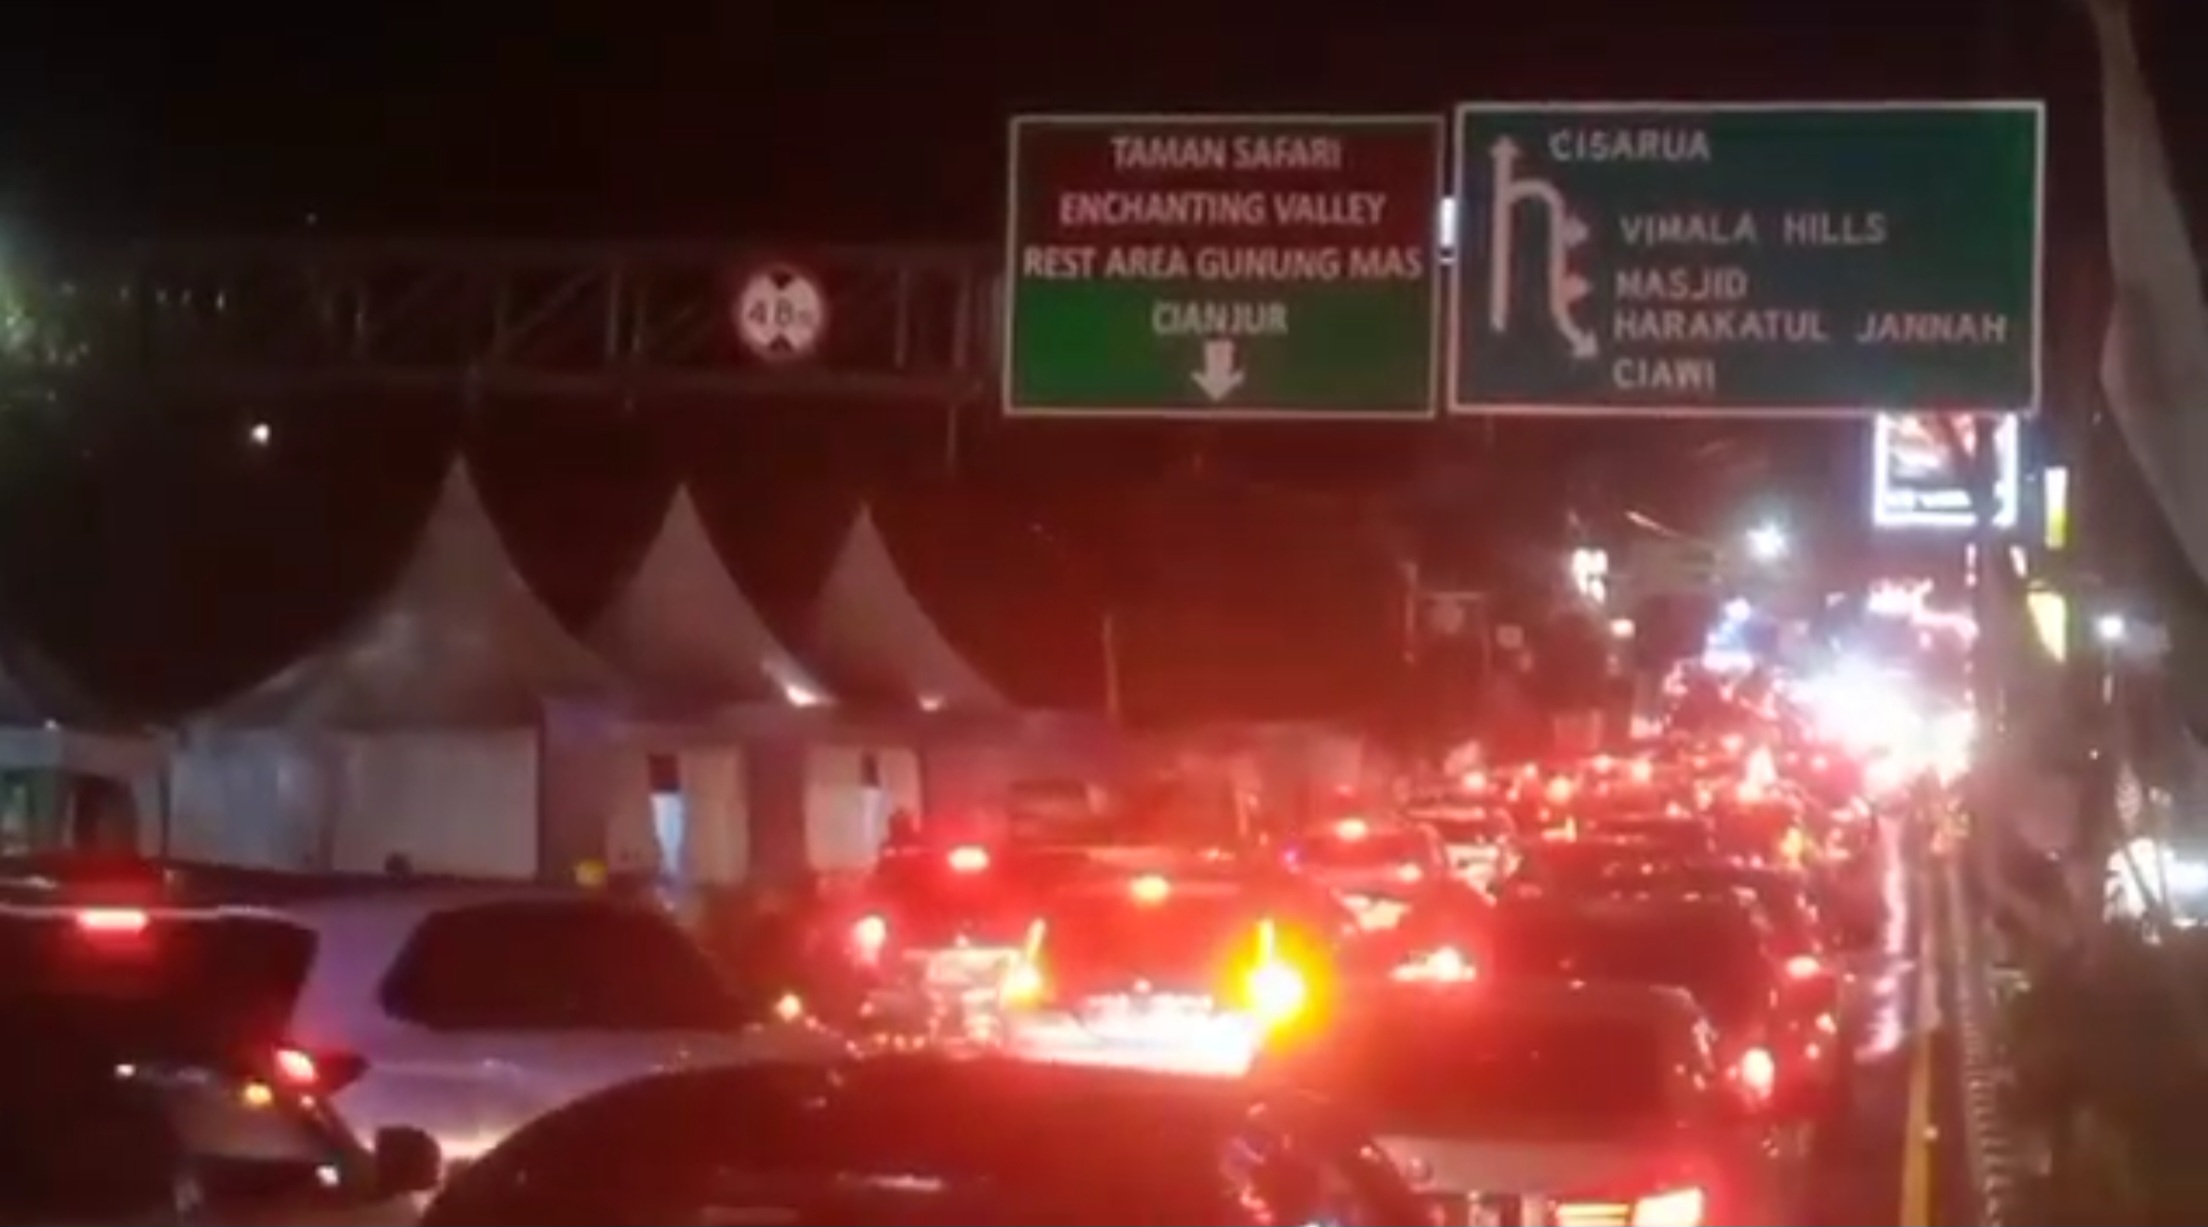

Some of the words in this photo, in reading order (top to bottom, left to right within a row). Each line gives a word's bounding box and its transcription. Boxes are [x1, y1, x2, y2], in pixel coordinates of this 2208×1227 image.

[1111, 136, 1225, 170] TAMAN
[1234, 136, 1342, 170] SAFARI
[1549, 129, 1710, 162] CISARUA
[1060, 192, 1264, 225] ENCHANTING
[1273, 193, 1387, 226] VALLEY
[1619, 213, 1757, 245] VIMALA
[1784, 212, 1887, 244] HILLS
[1023, 246, 1097, 278] REST
[1105, 246, 1189, 279] AREA
[1198, 247, 1340, 281] GUNUNG
[1348, 247, 1423, 279] MAS
[1615, 267, 1749, 299] MASJID
[1151, 301, 1289, 336] CIANJUR
[1613, 310, 1828, 343] HARAKATUL
[1856, 312, 2007, 344] JANNAH
[1612, 358, 1717, 391] CIAWI
